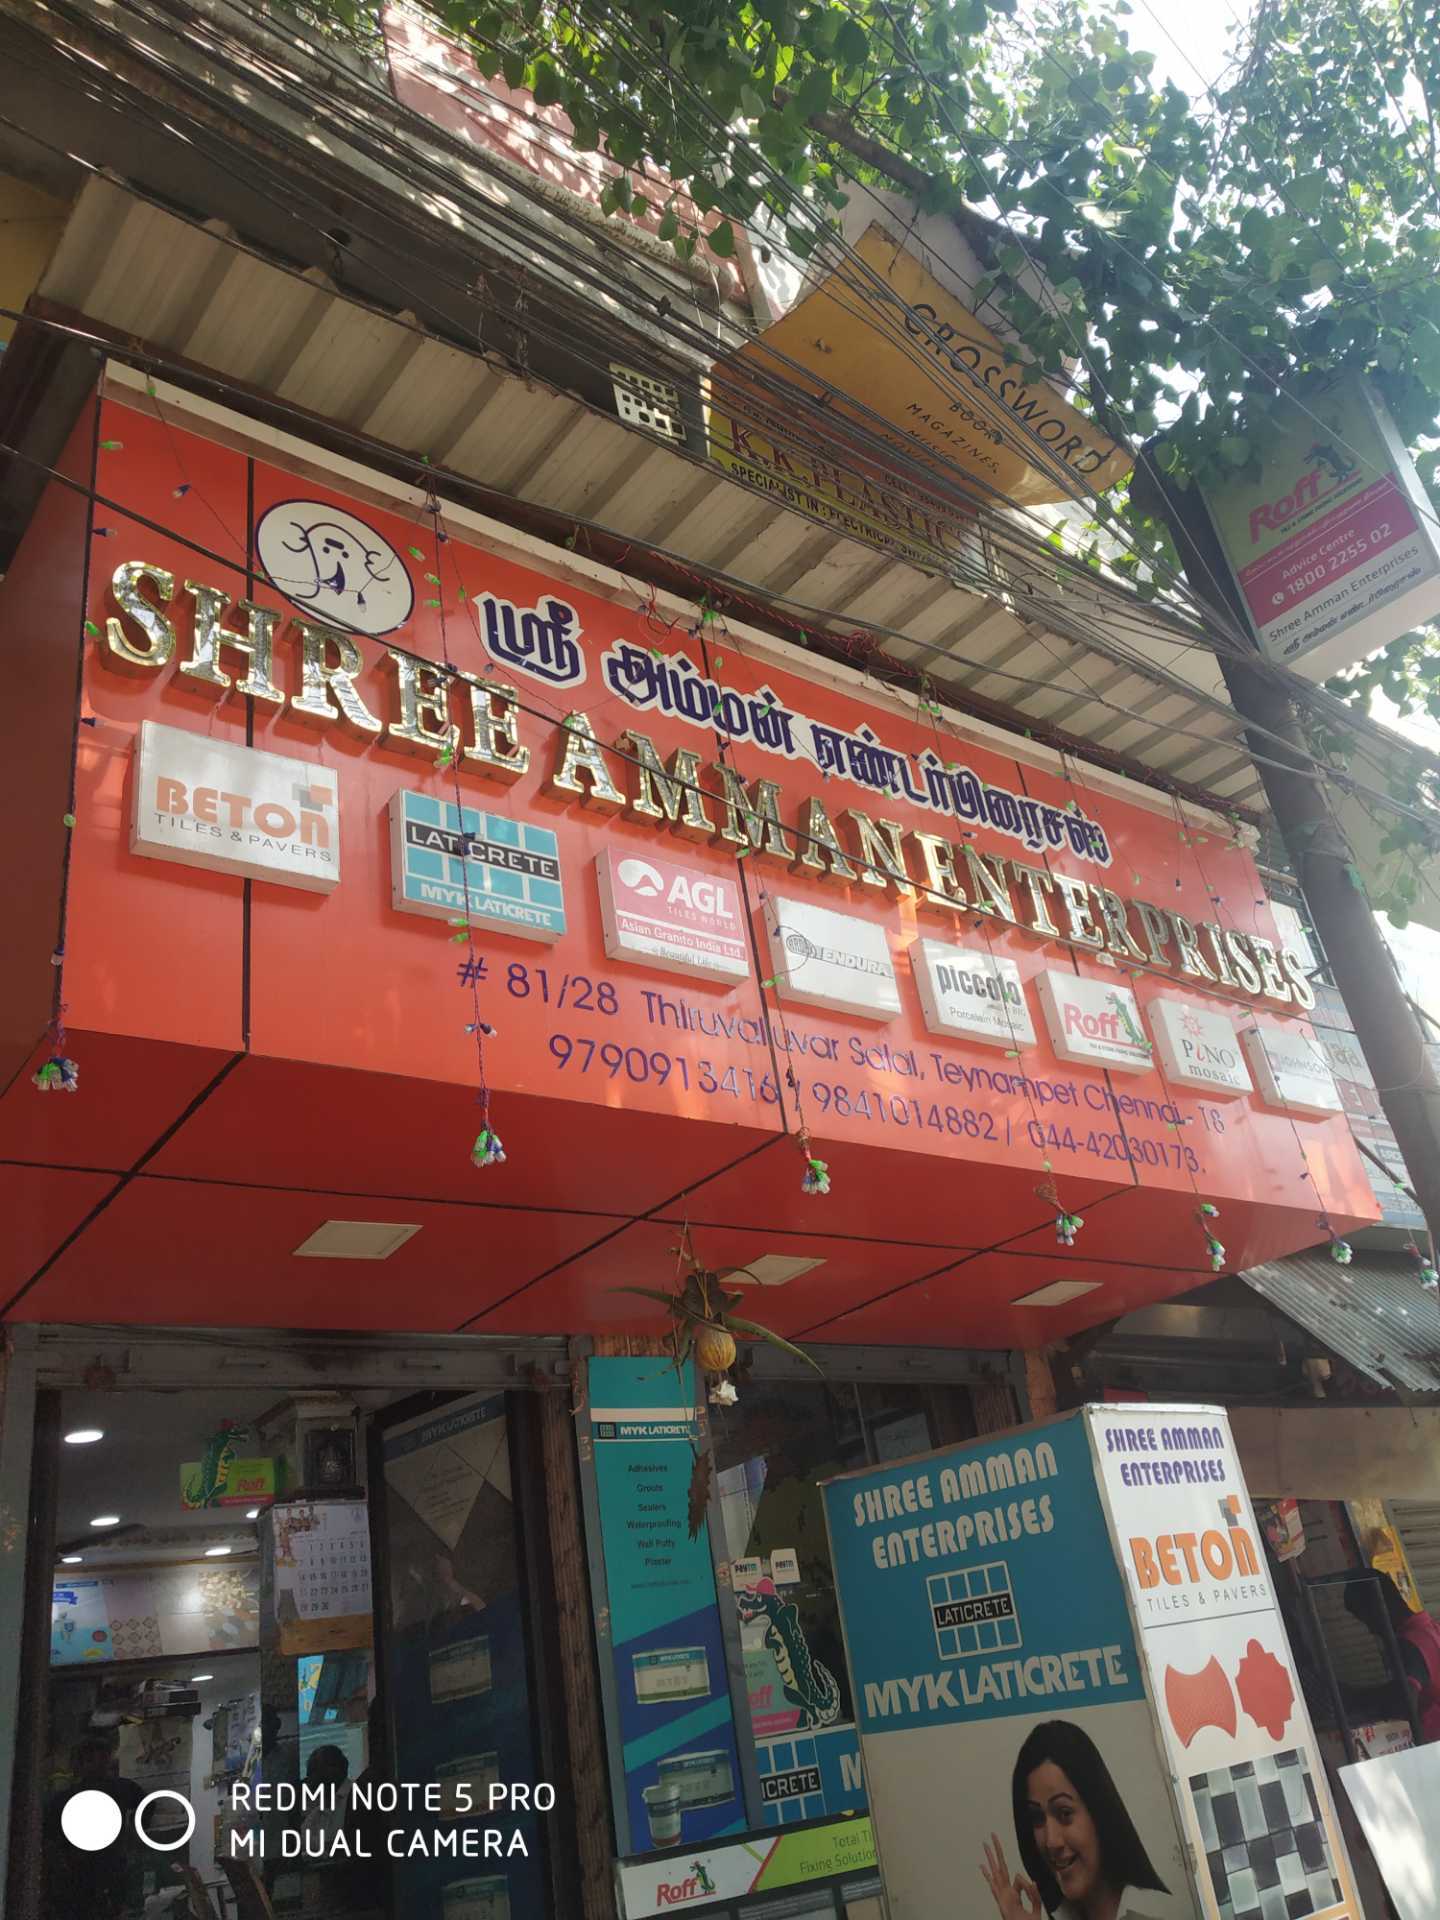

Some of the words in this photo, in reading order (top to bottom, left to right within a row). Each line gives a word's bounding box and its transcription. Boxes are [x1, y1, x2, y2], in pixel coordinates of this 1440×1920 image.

[1282, 551, 1318, 579] Advice
[1320, 528, 1355, 556] Centre
[1287, 565, 1326, 596] 1800
[1328, 539, 1367, 571] 2255
[1369, 523, 1393, 544] 02
[1269, 617, 1301, 642] Shree
[1303, 590, 1349, 622] Amman
[1350, 545, 1419, 592] Enterprises
[106, 560, 530, 775] SHREE
[553, 710, 915, 896] AMMAN
[914, 829, 1315, 1010] ENTERPRISES
[156, 775, 332, 849] BETON
[154, 812, 222, 838] TILES
[230, 830, 243, 842] &
[249, 835, 332, 862] PAVERS
[411, 826, 555, 877] LATCRETE
[667, 875, 734, 919] AGL
[622, 918, 651, 935] Asian
[654, 926, 694, 947] Granito
[696, 936, 722, 954] India
[936, 964, 1022, 1005] piccolo
[456, 957, 488, 988] #
[506, 963, 619, 1016] 81/28
[640, 990, 838, 1061] Thiruvalluvar
[930, 1053, 1079, 1107] Teynampet
[1063, 1003, 1119, 1039] Roff
[550, 1033, 781, 1105] 9790913416
[812, 1081, 999, 1141] 9841014882
[1187, 1061, 1241, 1086] mosaic
[620, 1426, 647, 1436] MYK
[1105, 1427, 1157, 1453] SHREE
[1160, 1426, 1225, 1451] AMMAN
[853, 1475, 934, 1527] SHREE
[940, 1442, 1058, 1504] AMMAN
[1120, 1459, 1226, 1487] ENTERPRISES
[872, 1494, 1054, 1569] ENTERPRISES
[1129, 1526, 1261, 1590] BETON
[936, 1597, 1011, 1627] LATICRETE
[1147, 1594, 1190, 1612] TILES
[1199, 1595, 1206, 1605] &
[1213, 1583, 1268, 1601] PAVERS
[863, 1670, 961, 1718] MYK
[960, 1644, 1128, 1706] LATICRETE
[832, 1832, 860, 1848] Total
[800, 1858, 833, 1874] Fixing
[657, 1877, 698, 1907] Roff
